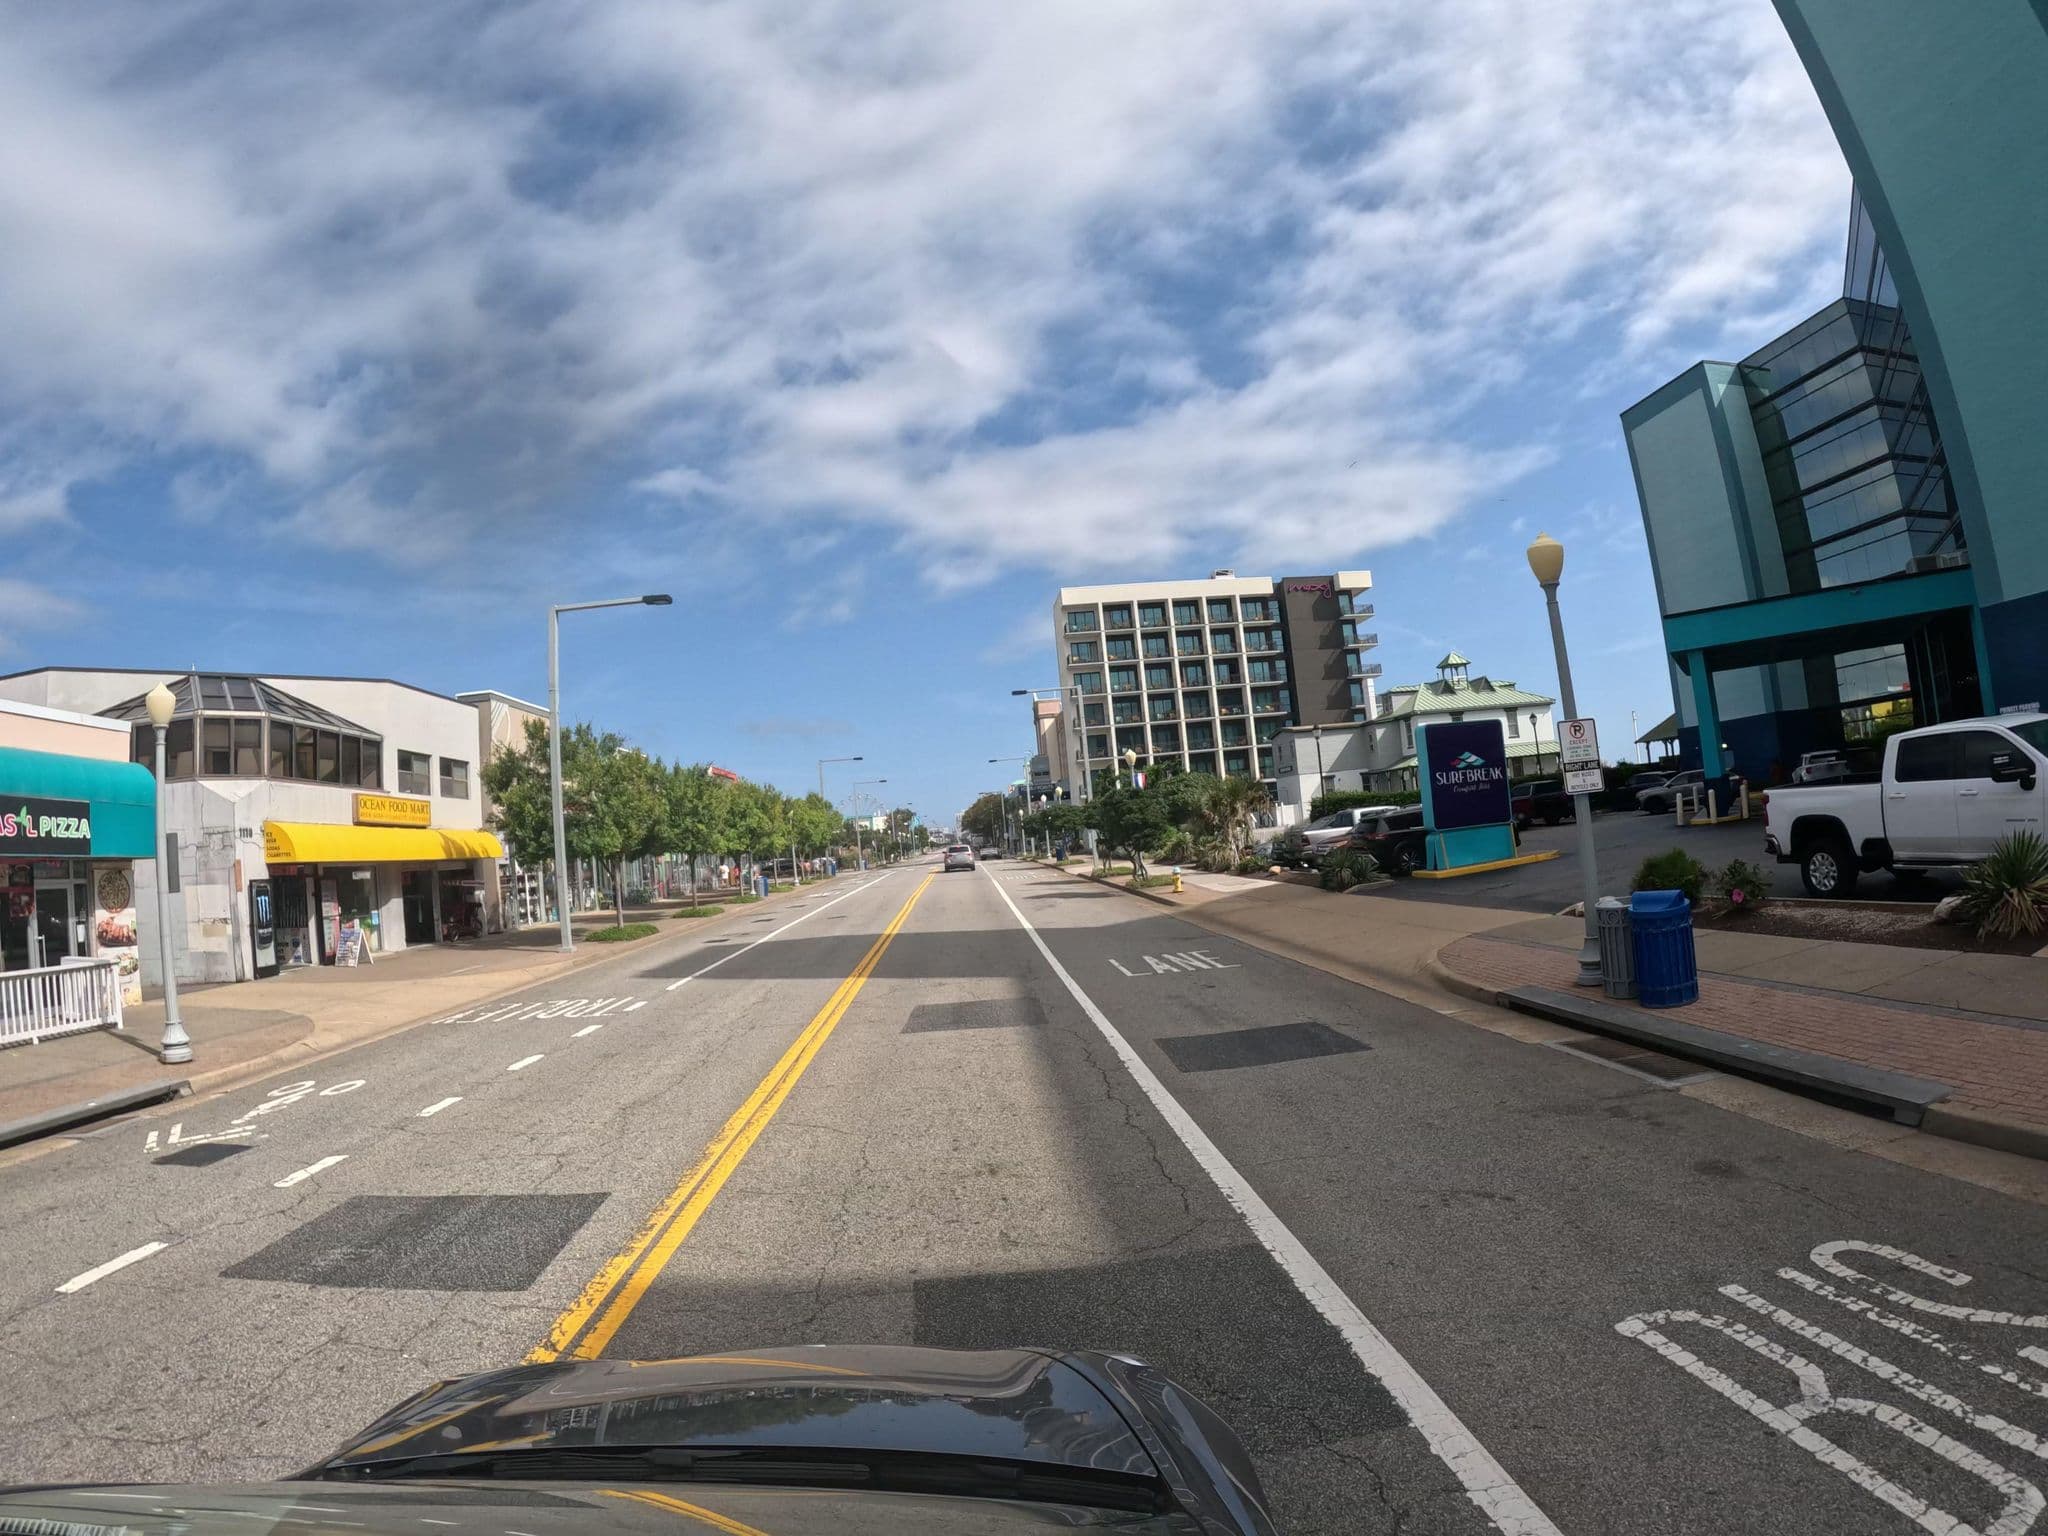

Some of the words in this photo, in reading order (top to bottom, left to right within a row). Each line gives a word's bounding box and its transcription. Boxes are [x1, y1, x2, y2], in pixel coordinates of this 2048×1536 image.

[1435, 767, 1503, 786] SURFBREAK
[360, 798, 386, 811] OCEAN
[388, 800, 408, 813] FOOD
[410, 803, 429, 815] MART
[39, 815, 91, 839] PIZZA
[1108, 950, 1242, 976] LANE
